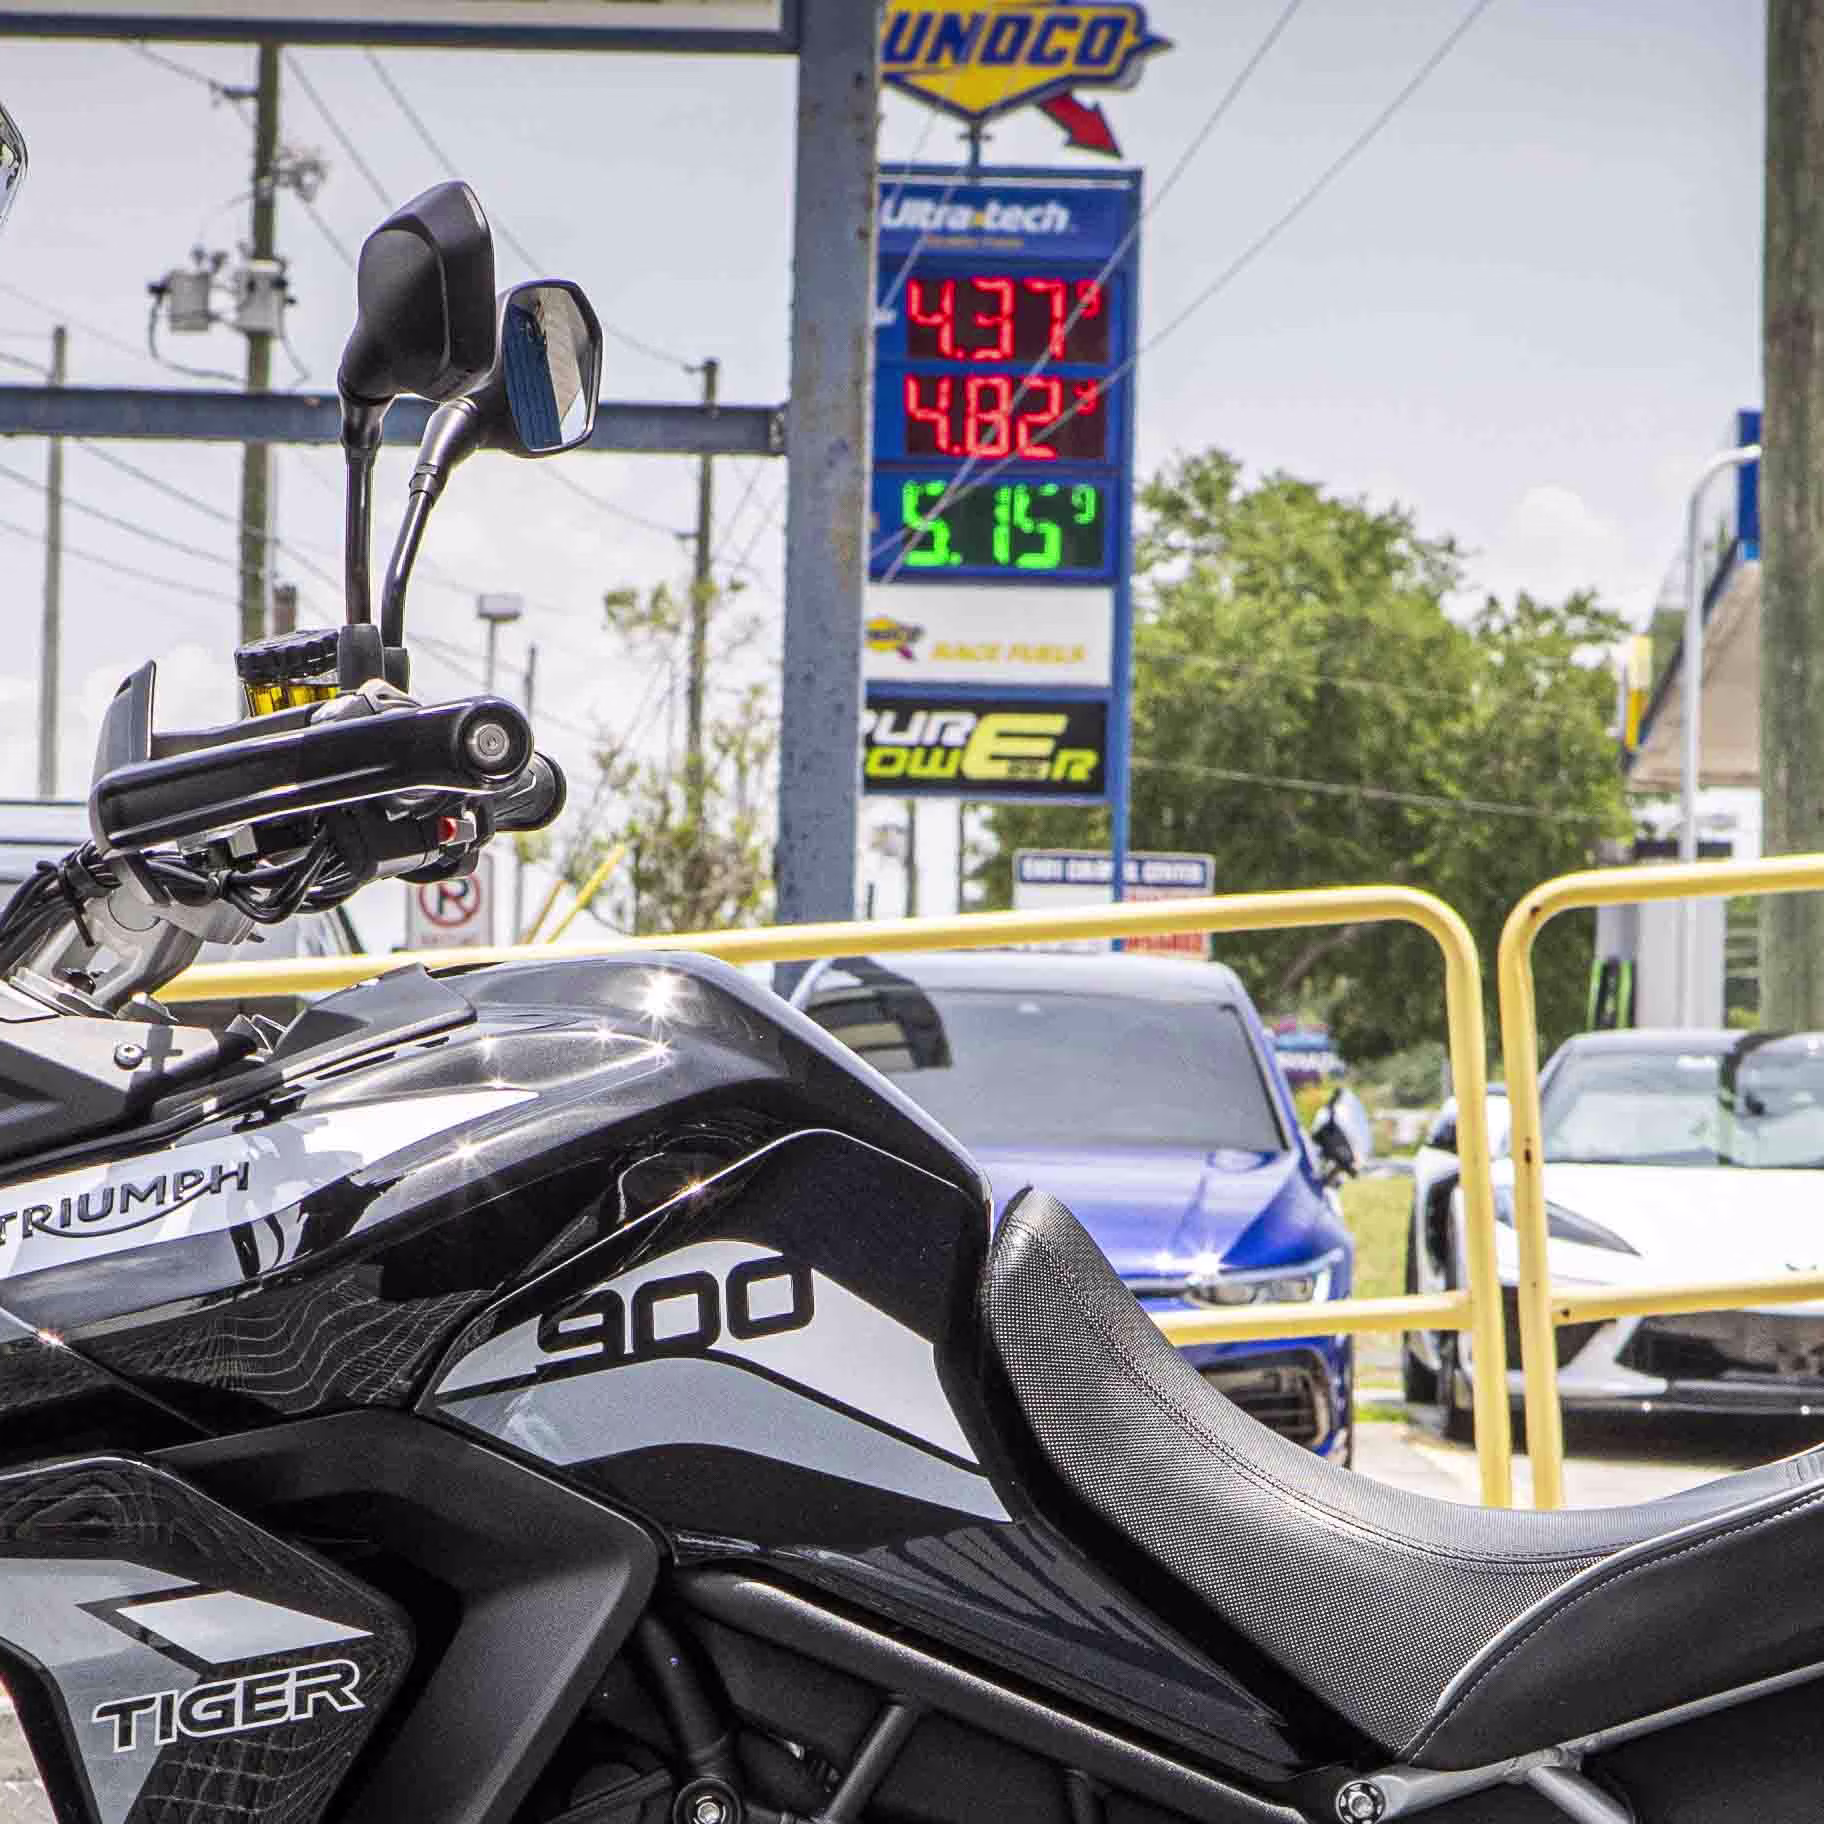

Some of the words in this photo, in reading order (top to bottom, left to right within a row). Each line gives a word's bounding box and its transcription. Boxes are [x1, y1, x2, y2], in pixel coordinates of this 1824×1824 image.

[881, 11, 1128, 66] UNOCO
[536, 1255, 815, 1372] 900
[92, 1658, 366, 1753] TIGER
